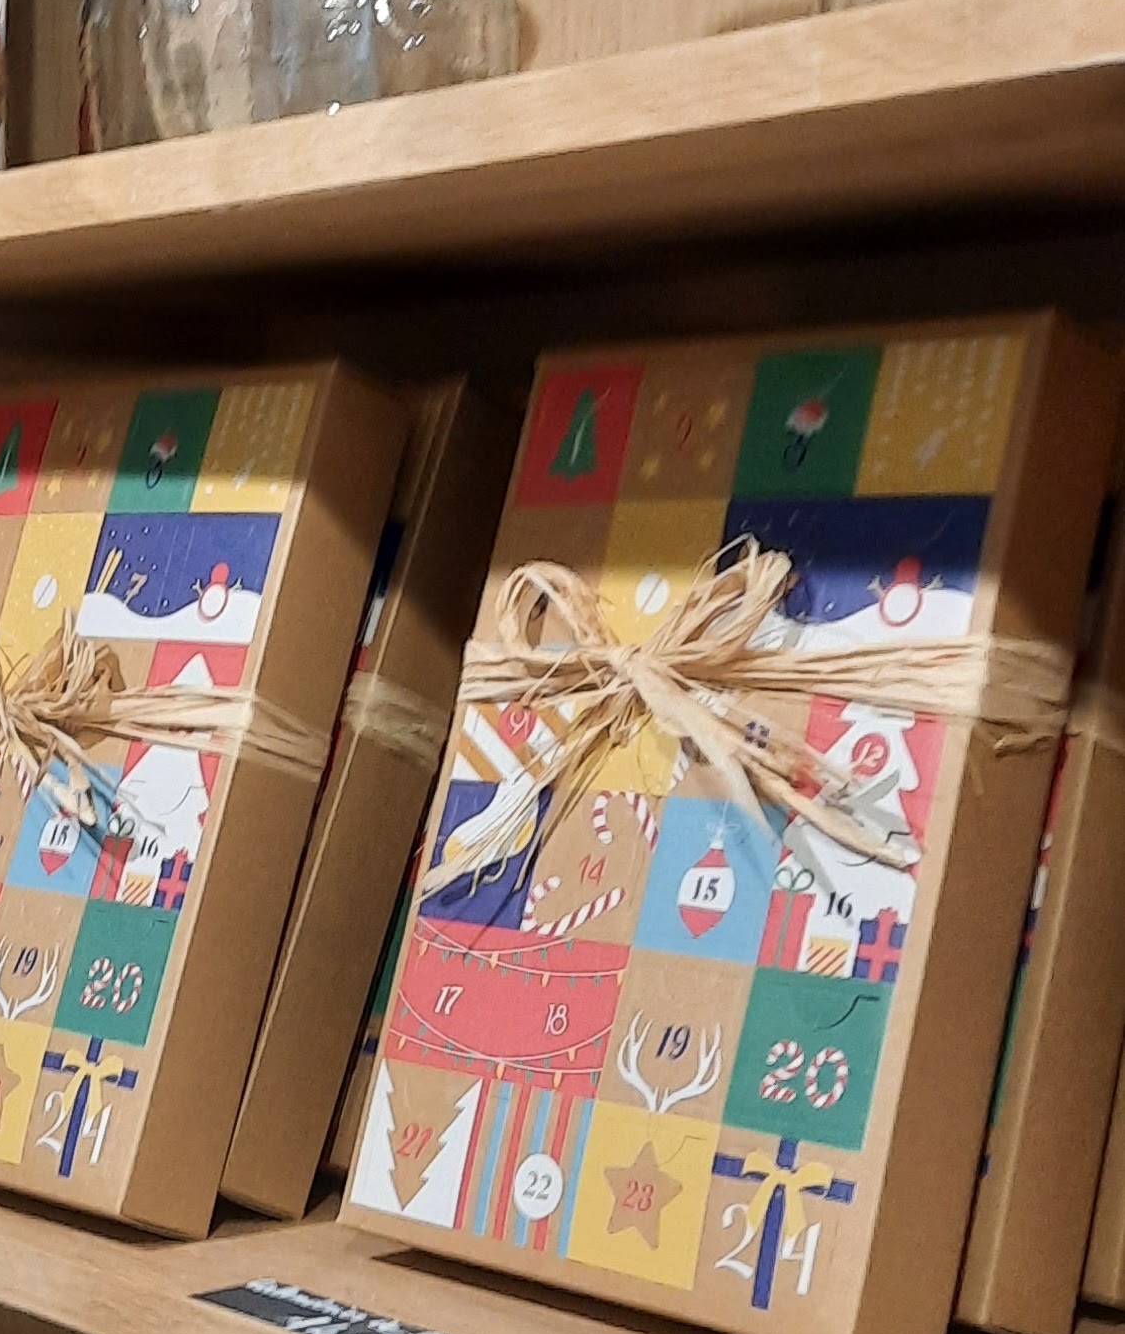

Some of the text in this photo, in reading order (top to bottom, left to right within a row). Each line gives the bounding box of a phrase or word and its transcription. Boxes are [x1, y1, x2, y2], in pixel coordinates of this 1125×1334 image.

[140, 836, 159, 860] 16
[578, 854, 606, 888] 14
[692, 875, 722, 904] 15
[824, 890, 853, 919] 16
[12, 946, 40, 978] 19
[81, 957, 144, 1014] 20
[433, 984, 464, 1016] 17
[543, 1002, 569, 1036] 18
[656, 1024, 692, 1061] 19
[759, 1038, 851, 1110] 20
[396, 1121, 434, 1159] 21
[522, 1169, 554, 1202] 22
[621, 1178, 656, 1213] 23
[713, 1202, 821, 1297] 24
